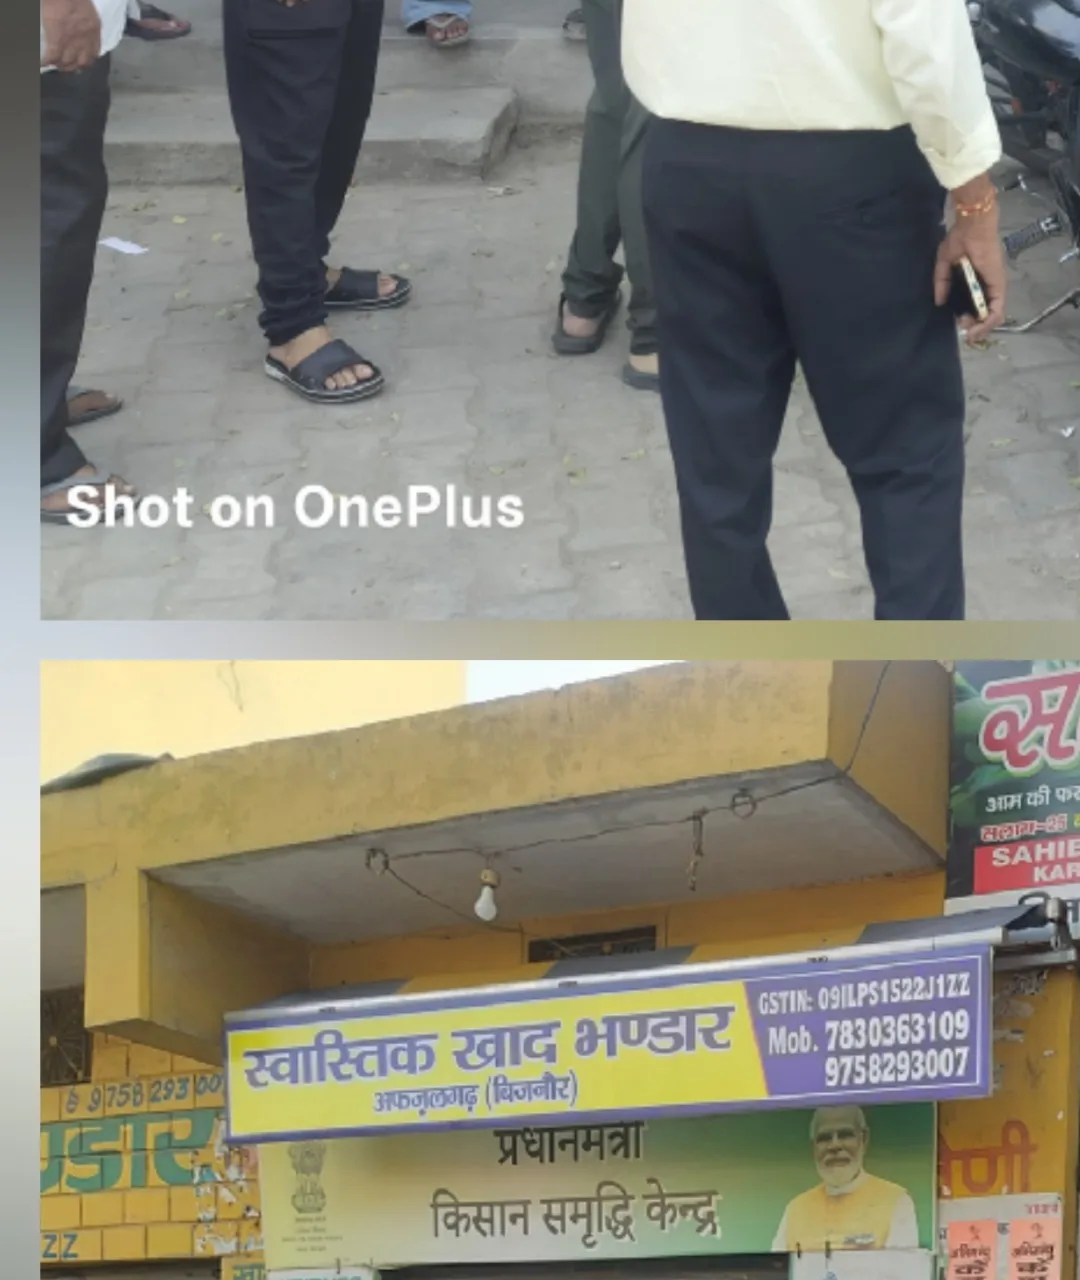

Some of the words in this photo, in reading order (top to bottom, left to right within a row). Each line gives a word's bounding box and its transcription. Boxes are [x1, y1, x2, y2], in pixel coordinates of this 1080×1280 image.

[985, 792, 1022, 813] आम
[1026, 784, 1052, 807] की
[759, 991, 814, 1016] GSTIN:
[818, 971, 970, 1011] 09ILPS1522J1ZZ
[244, 1028, 437, 1092] स्वास्तिक
[452, 1022, 559, 1073] खाद
[573, 1005, 736, 1060] भण्डार
[768, 1025, 819, 1055] Mob.
[825, 1009, 969, 1053] 7830363109
[825, 1046, 969, 1087] 9758293007
[486, 1068, 579, 1112] (बिजनौर)
[431, 1188, 530, 1239] किसान
[541, 1178, 637, 1244] समृद्धि
[645, 1175, 722, 1238] केन्द्र
